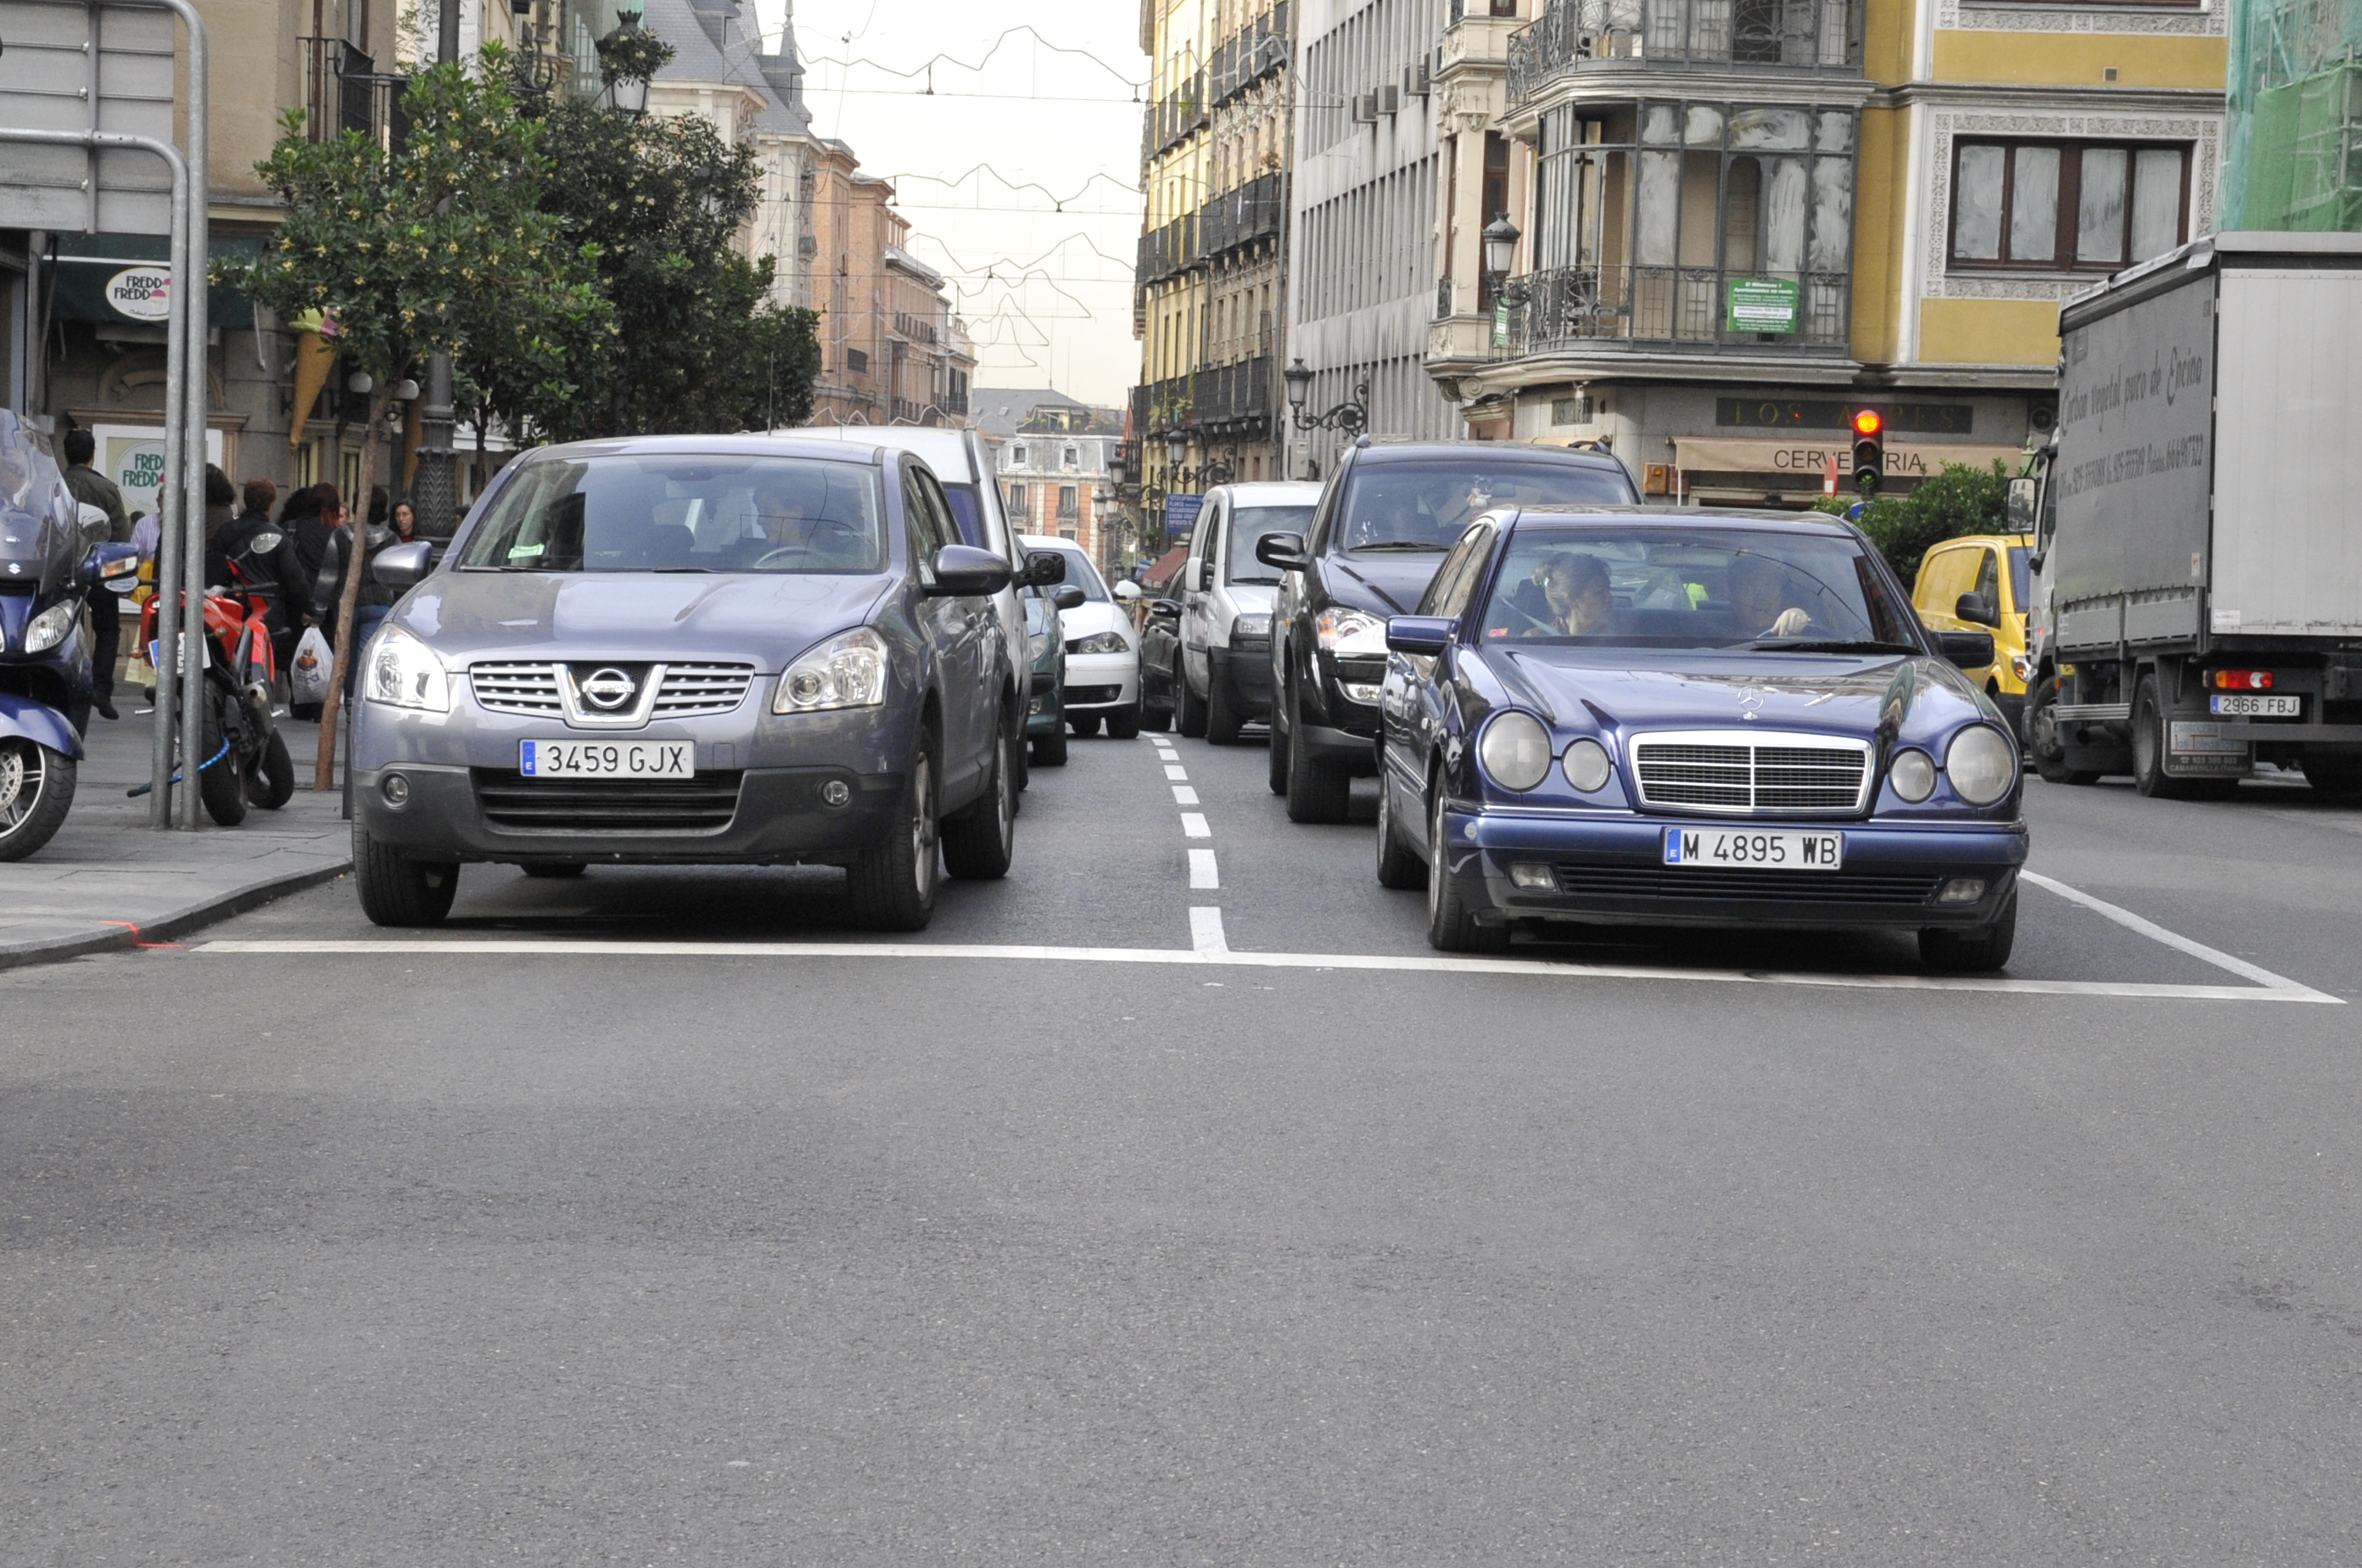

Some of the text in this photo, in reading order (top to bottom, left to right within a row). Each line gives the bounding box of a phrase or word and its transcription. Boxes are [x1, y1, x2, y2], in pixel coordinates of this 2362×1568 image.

[1735, 401, 1956, 429] LOS APES
[1774, 450, 1923, 470] CERVERIA
[2223, 698, 2259, 713] 2966
[2267, 698, 2297, 714] FBJ
[547, 745, 618, 773] 3459
[629, 746, 684, 773] GJX
[1683, 833, 1699, 860] M
[1713, 834, 1786, 863] 4895
[1802, 837, 1836, 865] WB
